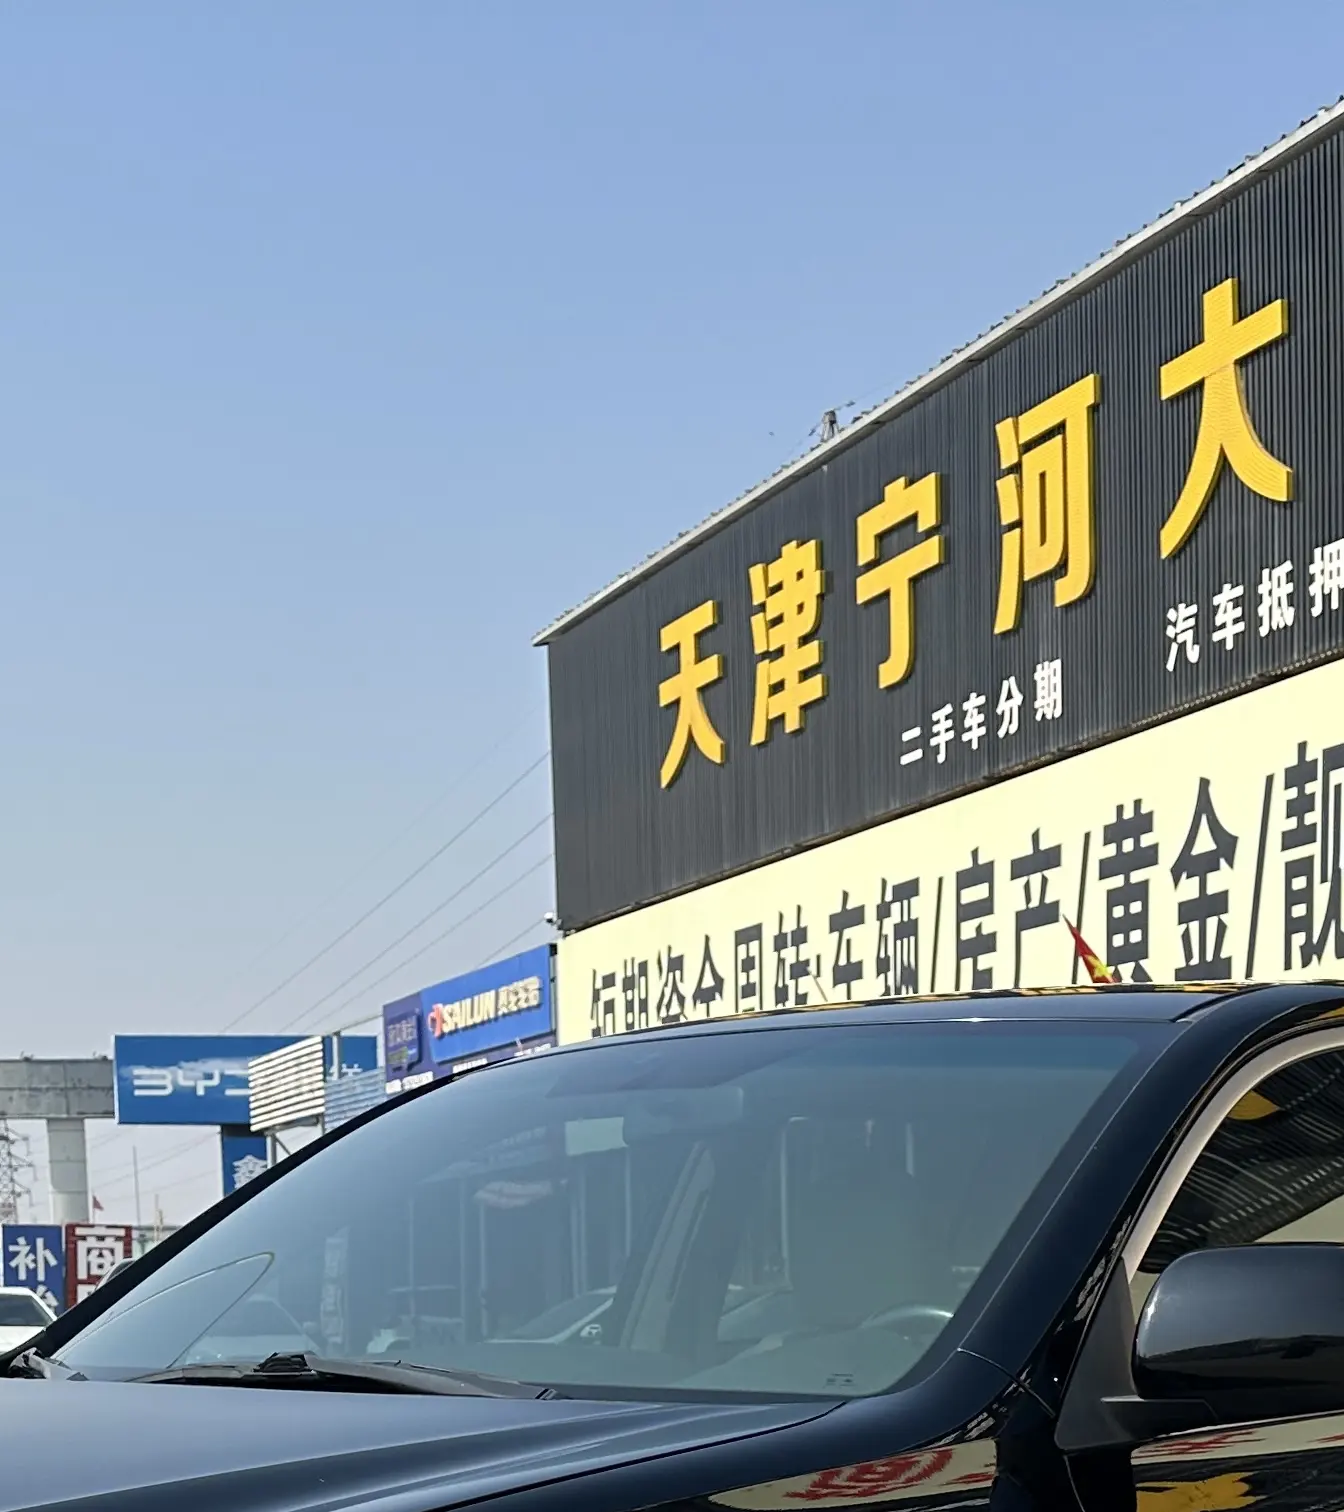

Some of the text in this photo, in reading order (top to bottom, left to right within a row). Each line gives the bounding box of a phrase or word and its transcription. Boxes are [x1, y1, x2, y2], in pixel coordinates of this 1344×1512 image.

[900, 658, 1063, 766] 二手车分期
